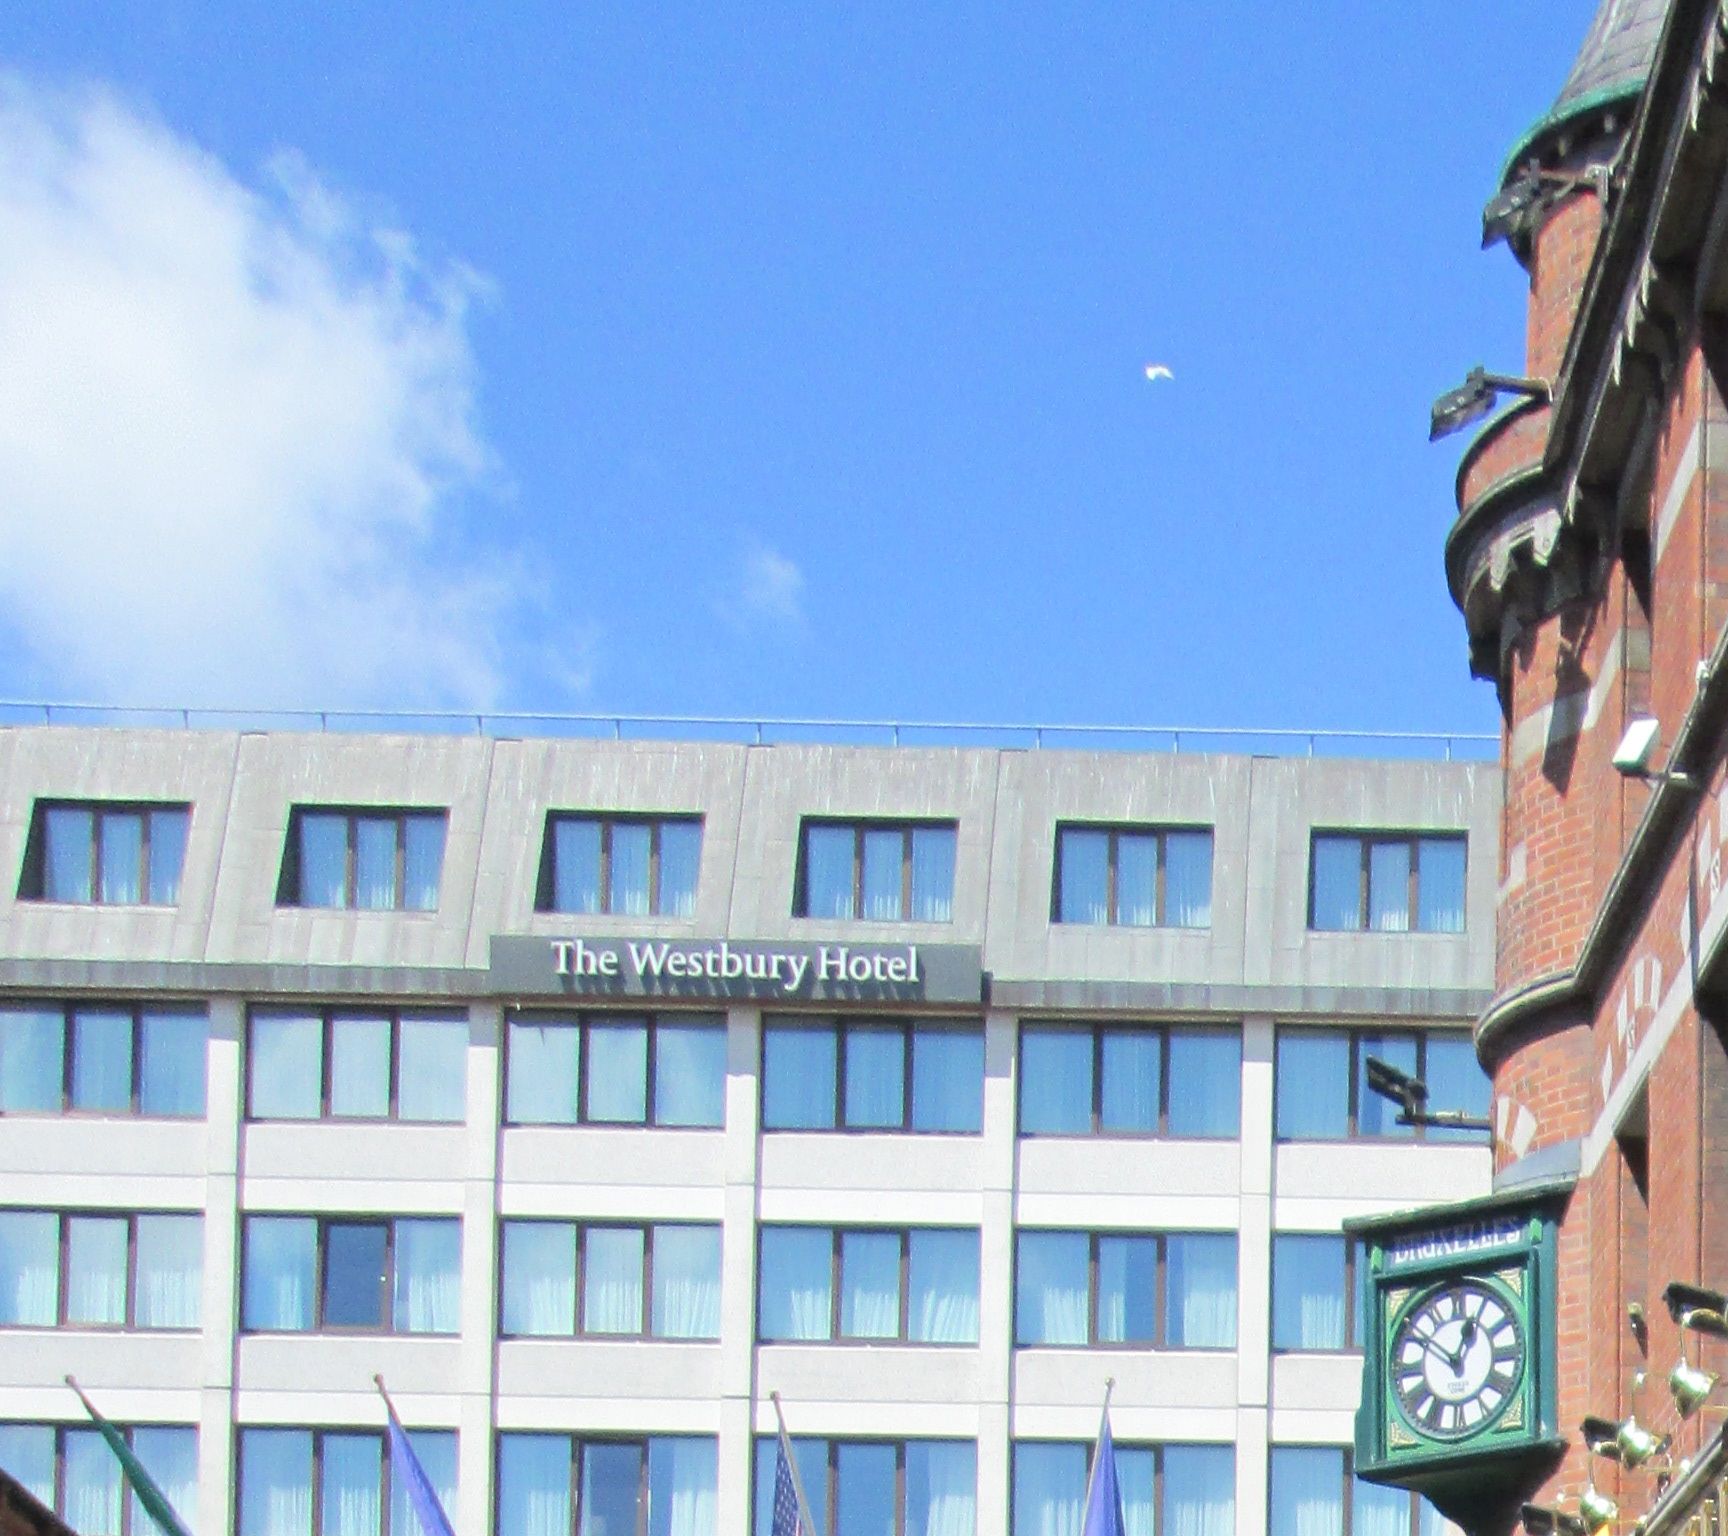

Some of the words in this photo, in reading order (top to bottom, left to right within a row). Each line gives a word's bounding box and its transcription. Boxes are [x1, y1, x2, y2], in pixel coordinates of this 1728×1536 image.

[550, 940, 618, 975] The
[628, 941, 809, 990] Westbury
[819, 945, 920, 983] Hotel
